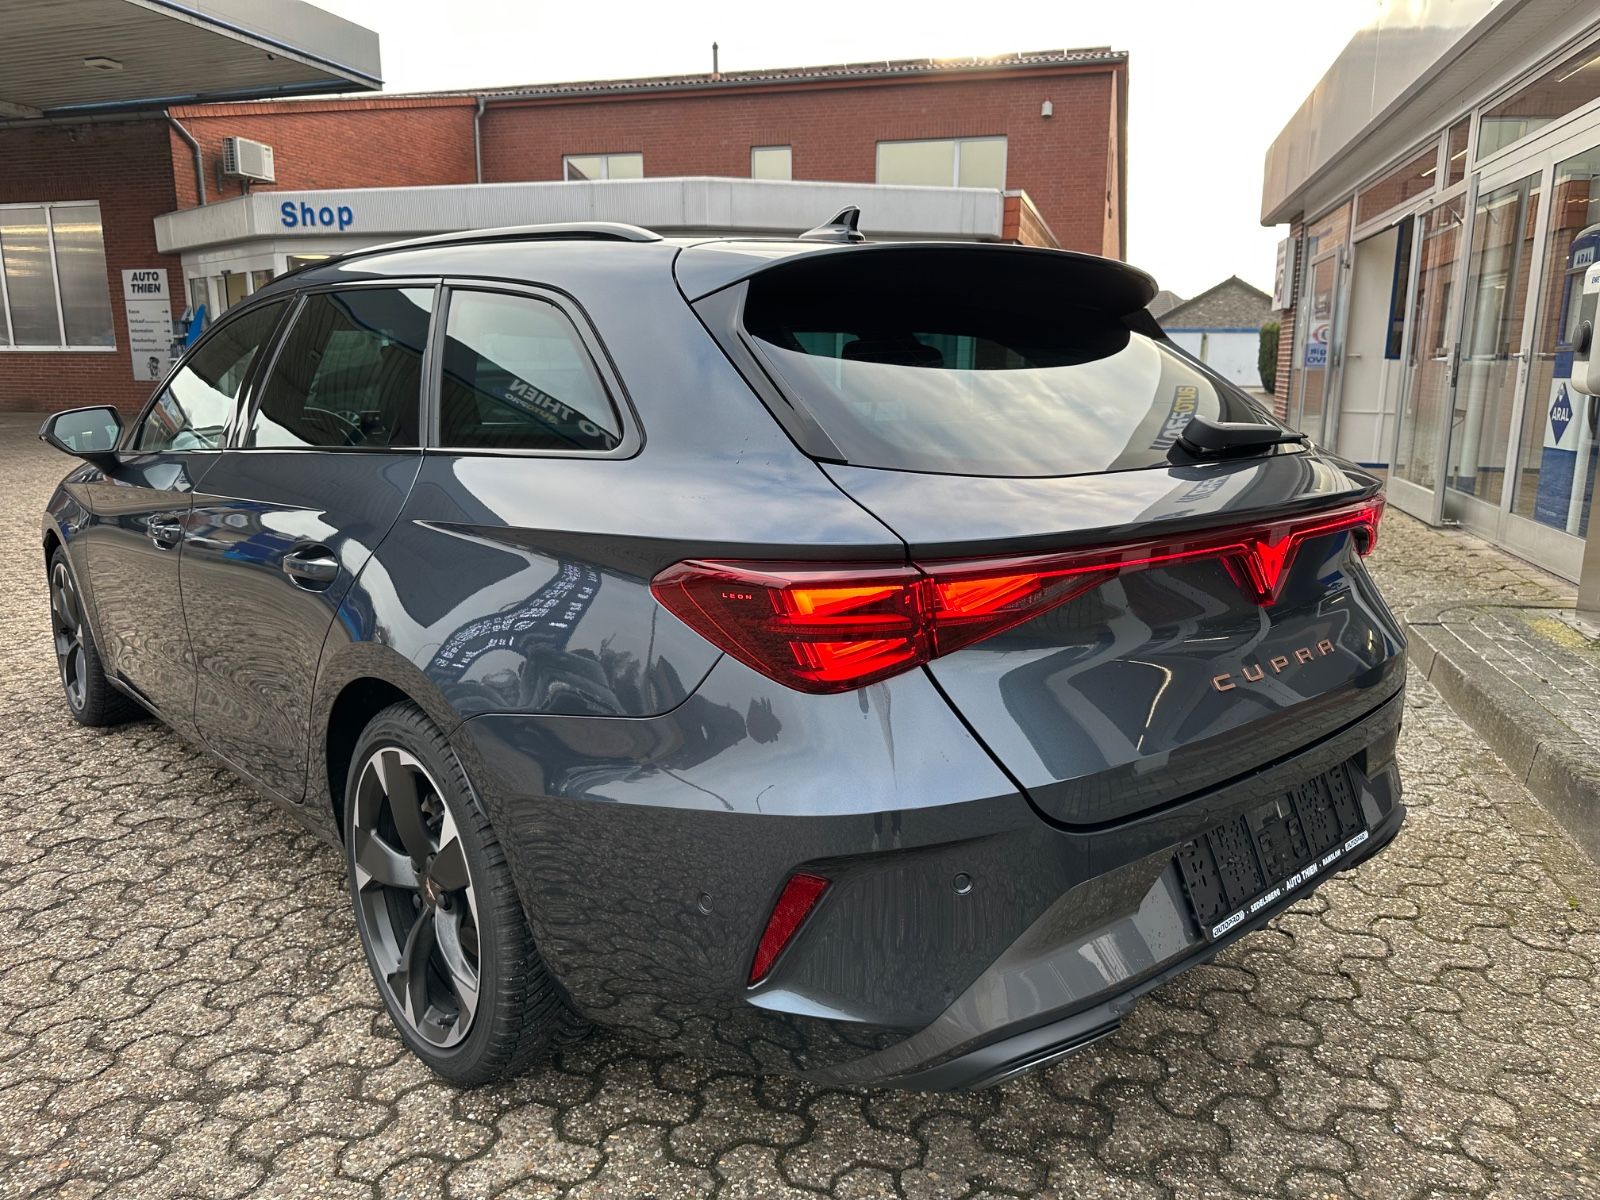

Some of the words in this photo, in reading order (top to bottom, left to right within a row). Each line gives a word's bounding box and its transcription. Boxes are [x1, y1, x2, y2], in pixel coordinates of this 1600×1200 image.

[281, 201, 353, 231] Shop
[1576, 251, 1592, 264] ARAL
[131, 271, 159, 282] AUTO
[131, 283, 160, 294] THIEN
[1552, 407, 1569, 421] ARAL
[722, 592, 752, 600] LEON
[1210, 639, 1335, 692] CUPRA
[1250, 888, 1281, 913] SEDELSBERG
[1286, 874, 1302, 891] AUTO
[1301, 862, 1318, 880] THIEN
